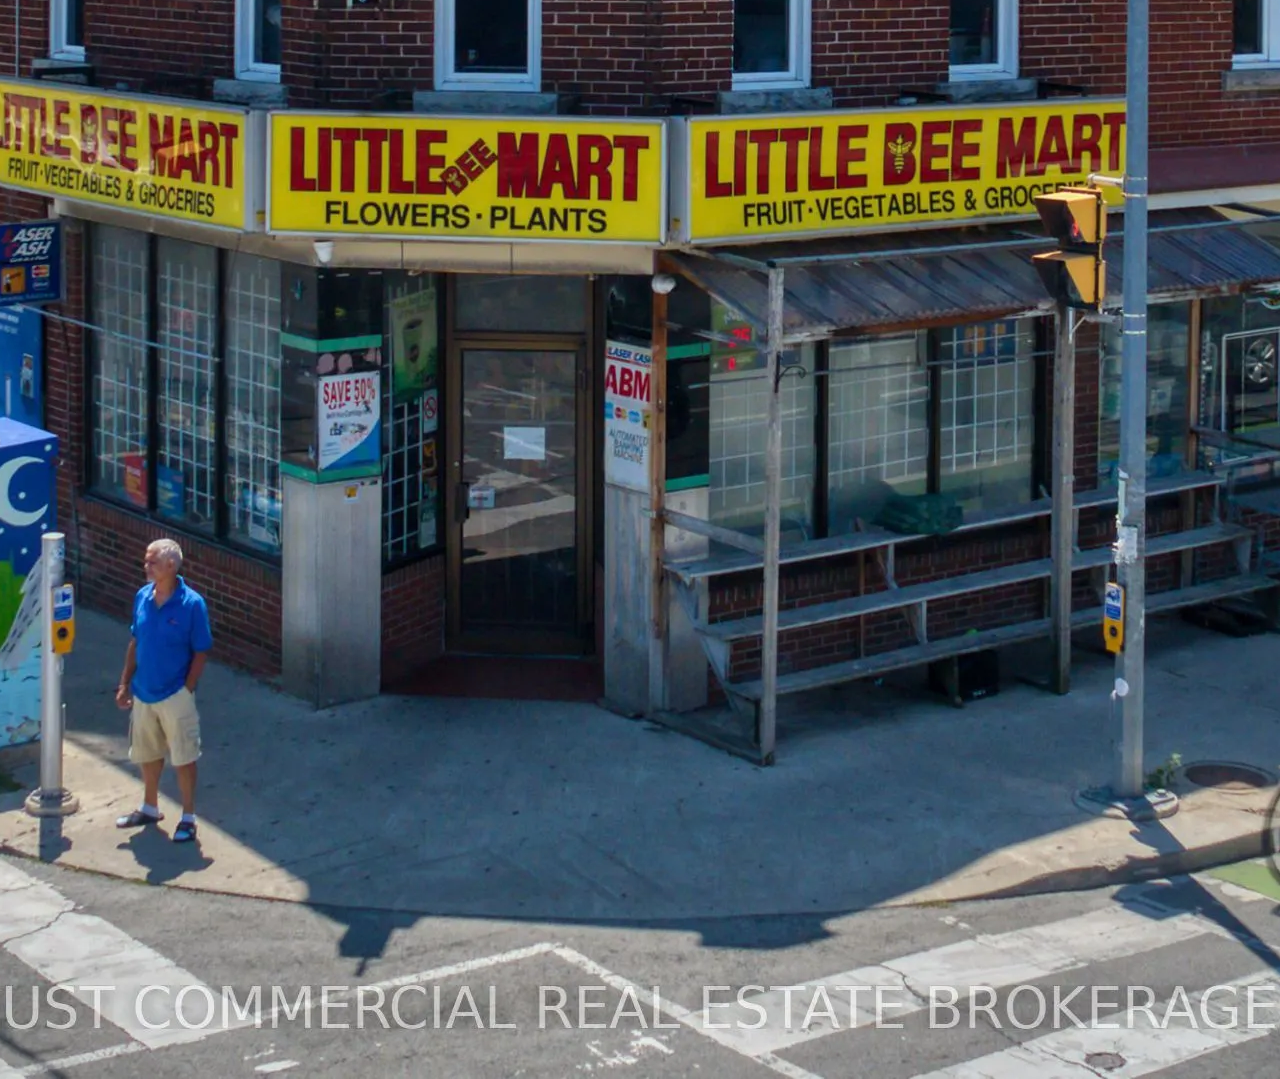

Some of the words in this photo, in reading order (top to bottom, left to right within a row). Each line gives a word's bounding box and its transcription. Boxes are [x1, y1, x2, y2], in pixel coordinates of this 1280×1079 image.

[80, 104, 137, 171] BEE
[149, 113, 238, 188] MART
[290, 127, 448, 196] LITTLE
[439, 138, 498, 197] BEE
[497, 132, 649, 202] MART
[705, 124, 869, 198] LITTLE
[883, 119, 983, 186] BEE
[996, 111, 1127, 179] MART
[126, 180, 134, 202] &
[139, 182, 215, 217] GROCERIES
[325, 201, 470, 229] FLOWERS
[489, 206, 607, 233] PLANTS
[964, 189, 977, 211] &
[323, 381, 351, 405] SAVE
[354, 378, 376, 401] 50%
[605, 364, 651, 403] ABM
